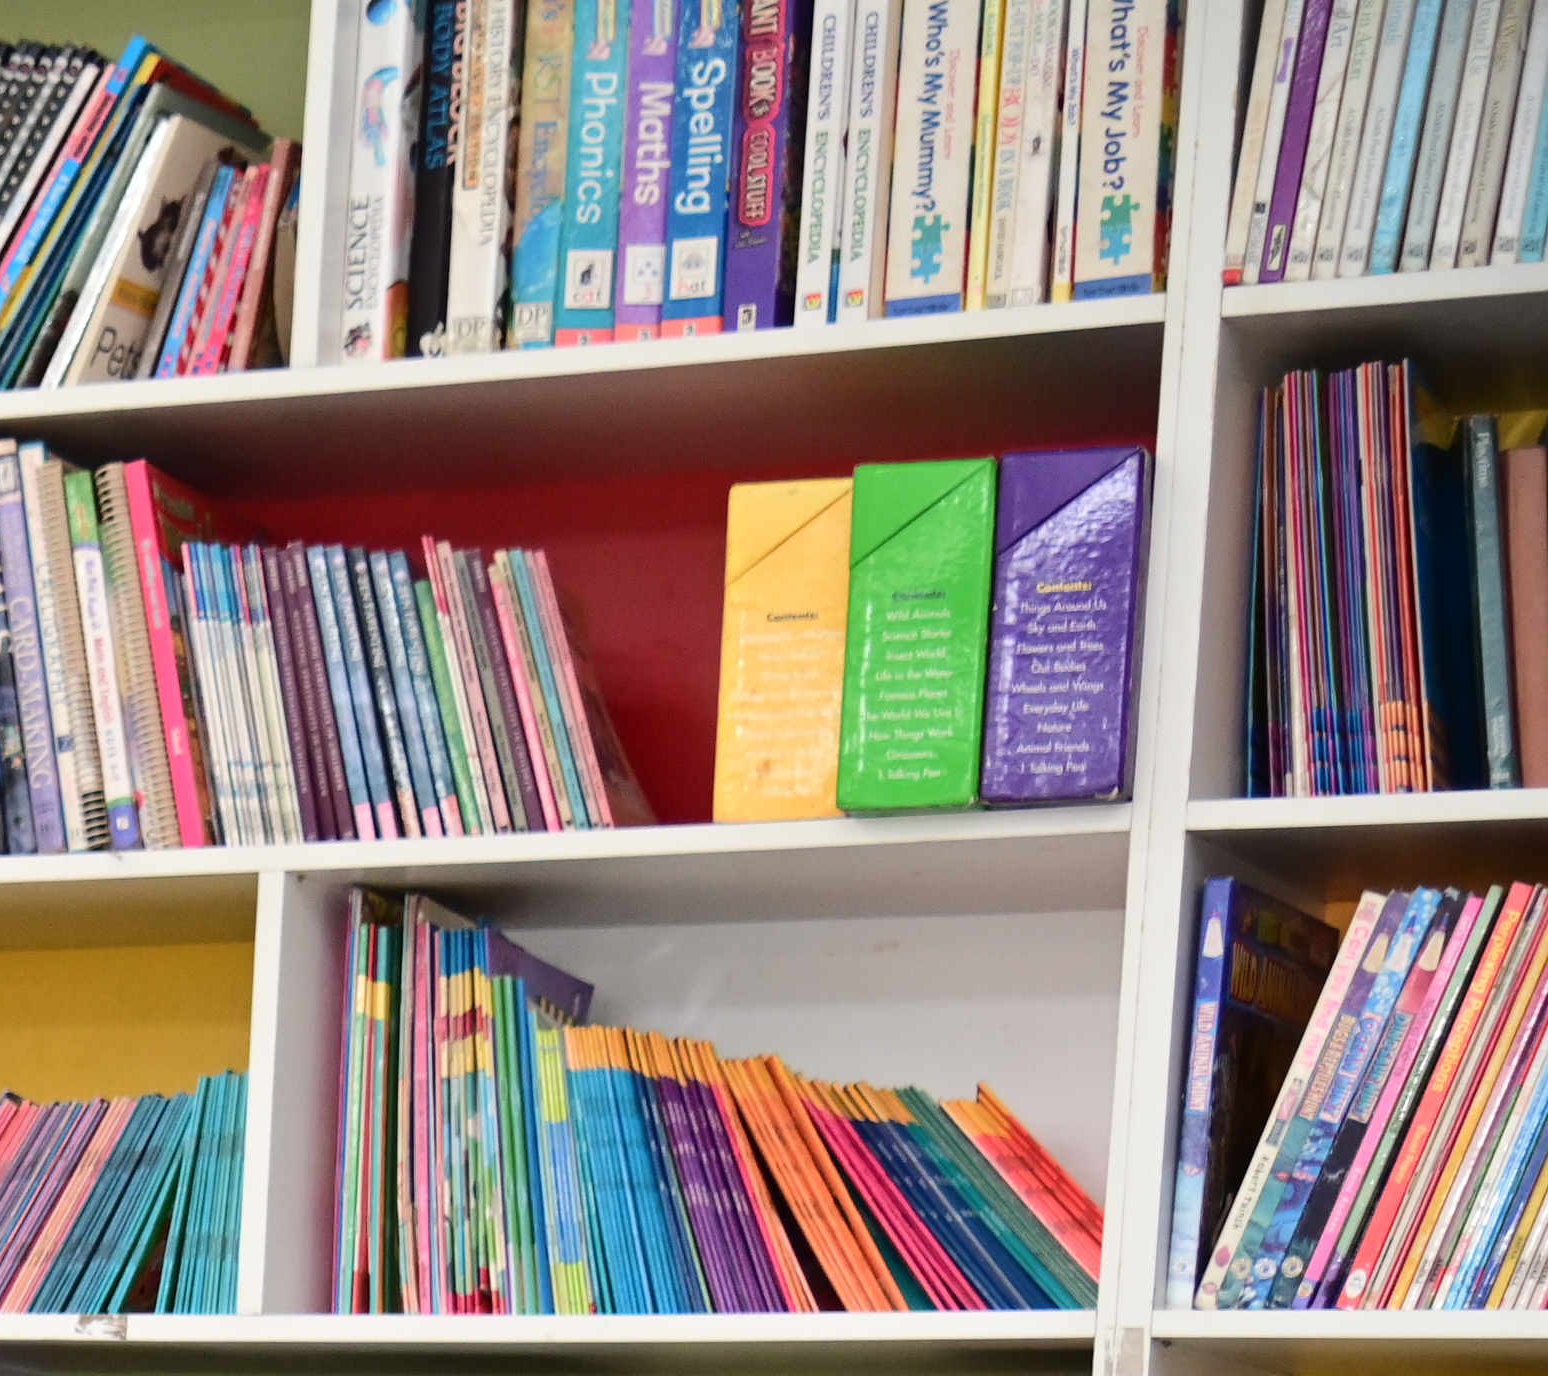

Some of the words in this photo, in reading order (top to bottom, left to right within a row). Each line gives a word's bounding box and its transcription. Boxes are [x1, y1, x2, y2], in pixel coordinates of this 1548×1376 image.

[818, 14, 837, 121] CHILDREN'S
[925, 2, 949, 67] Who's
[634, 82, 675, 206] Maths
[674, 57, 727, 214] Spelling
[917, 72, 944, 111] My
[575, 71, 619, 225] Phonics
[807, 130, 829, 263] ENCYCLOPEDIA
[911, 110, 942, 212] Mummy?
[345, 194, 369, 312] SCIENCE
[9, 596, 53, 790] CARD-MAKING
[1471, 908, 1521, 998] Perplexing
[1432, 996, 1484, 1093] Perceptions
